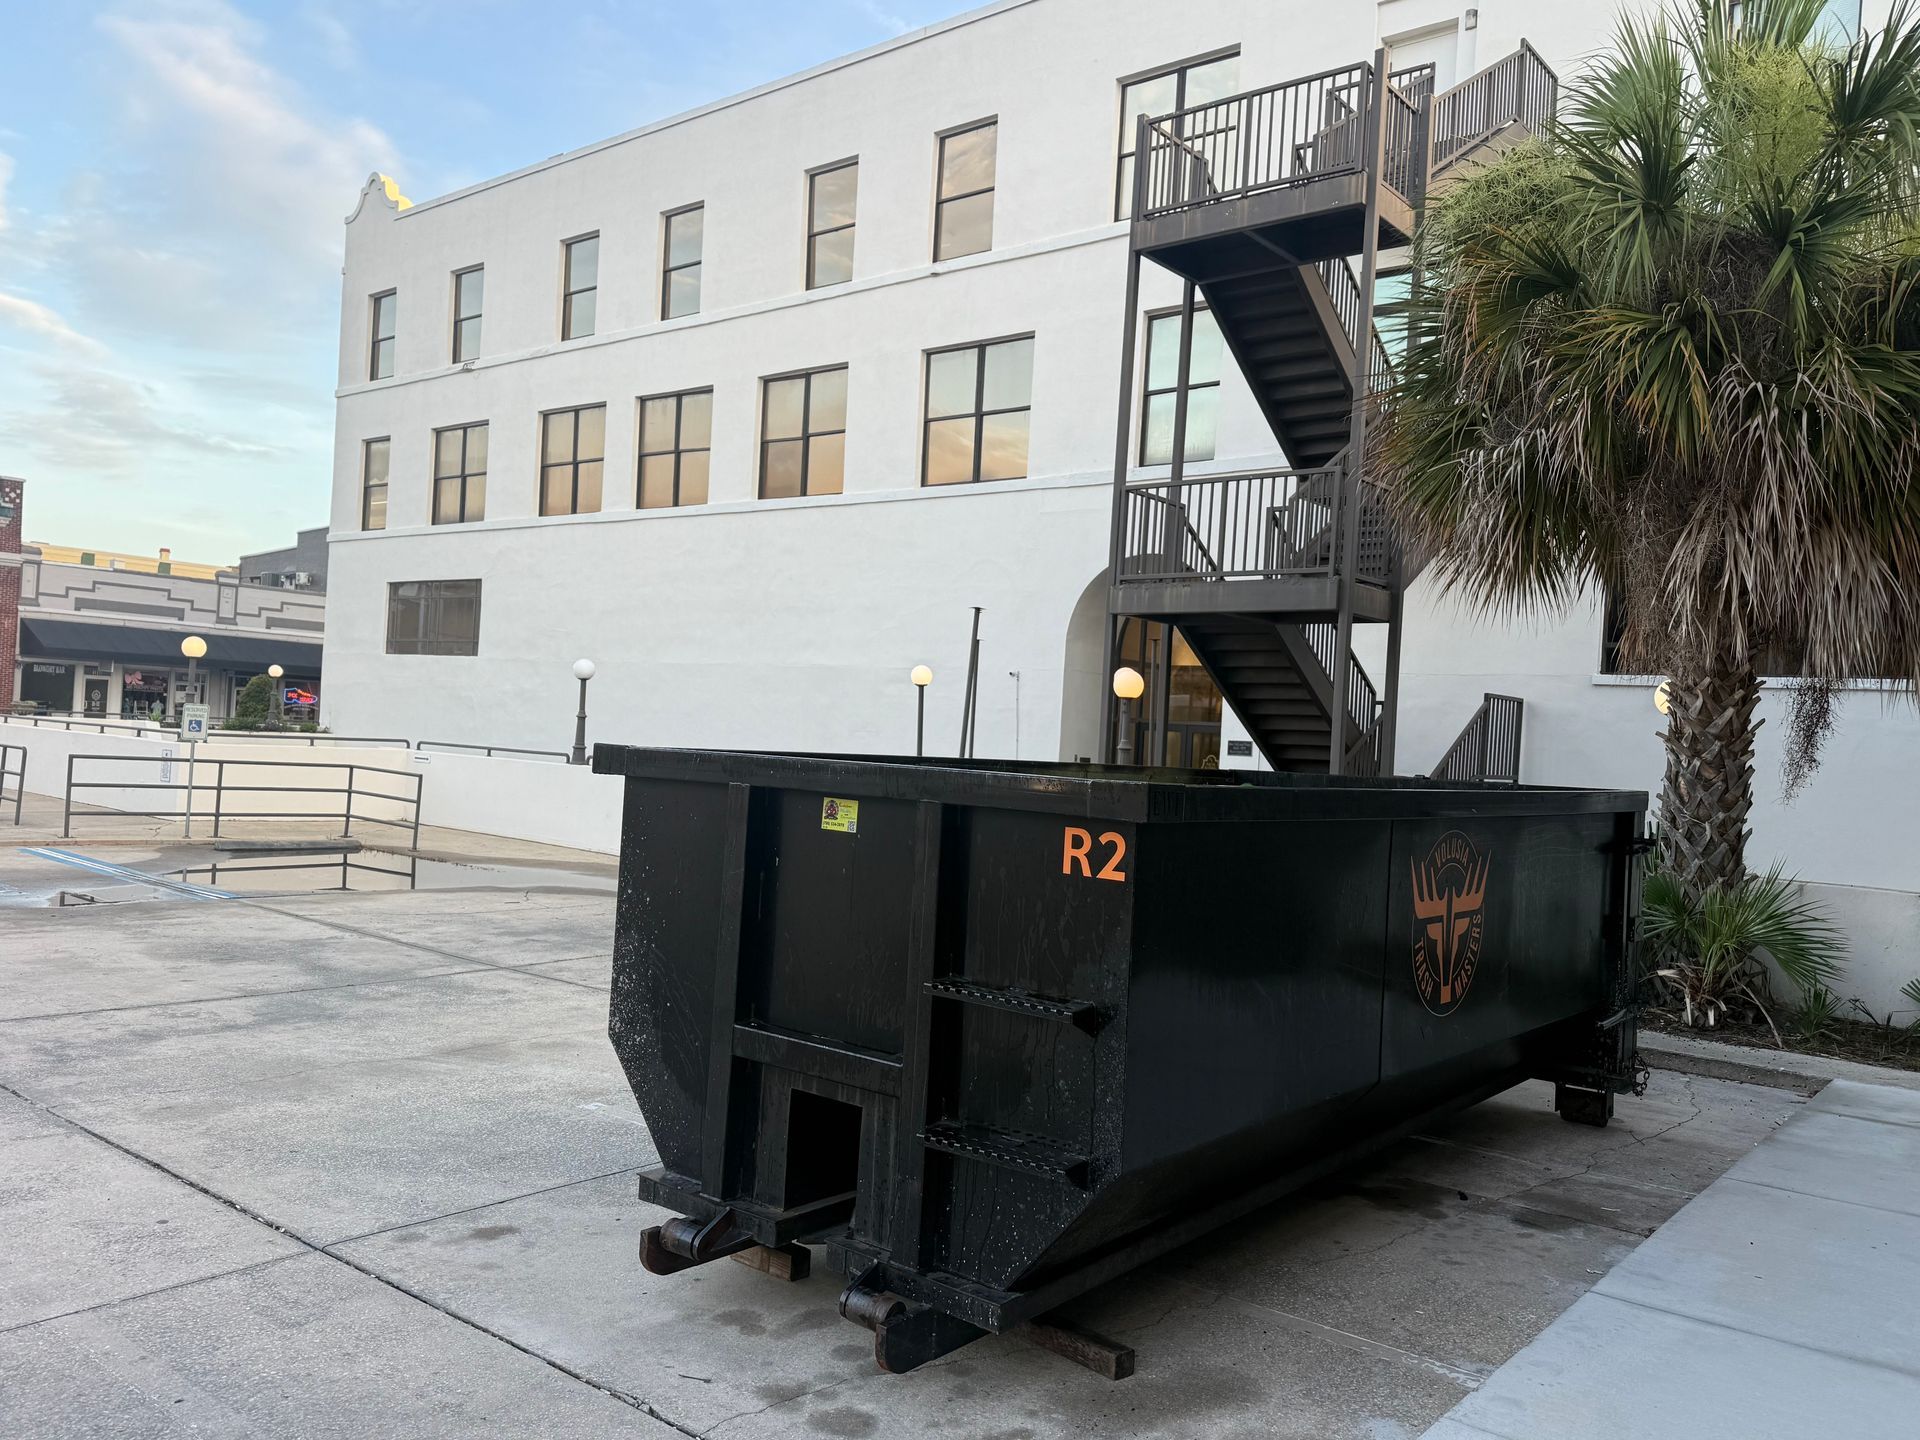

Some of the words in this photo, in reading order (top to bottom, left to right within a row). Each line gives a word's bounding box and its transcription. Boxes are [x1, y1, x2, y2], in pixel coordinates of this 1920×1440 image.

[1062, 826, 1126, 882] R2
[1435, 837, 1469, 868] VOLUSIA
[1414, 937, 1434, 1000] TRASH
[1454, 913, 1482, 999] MASTERS
